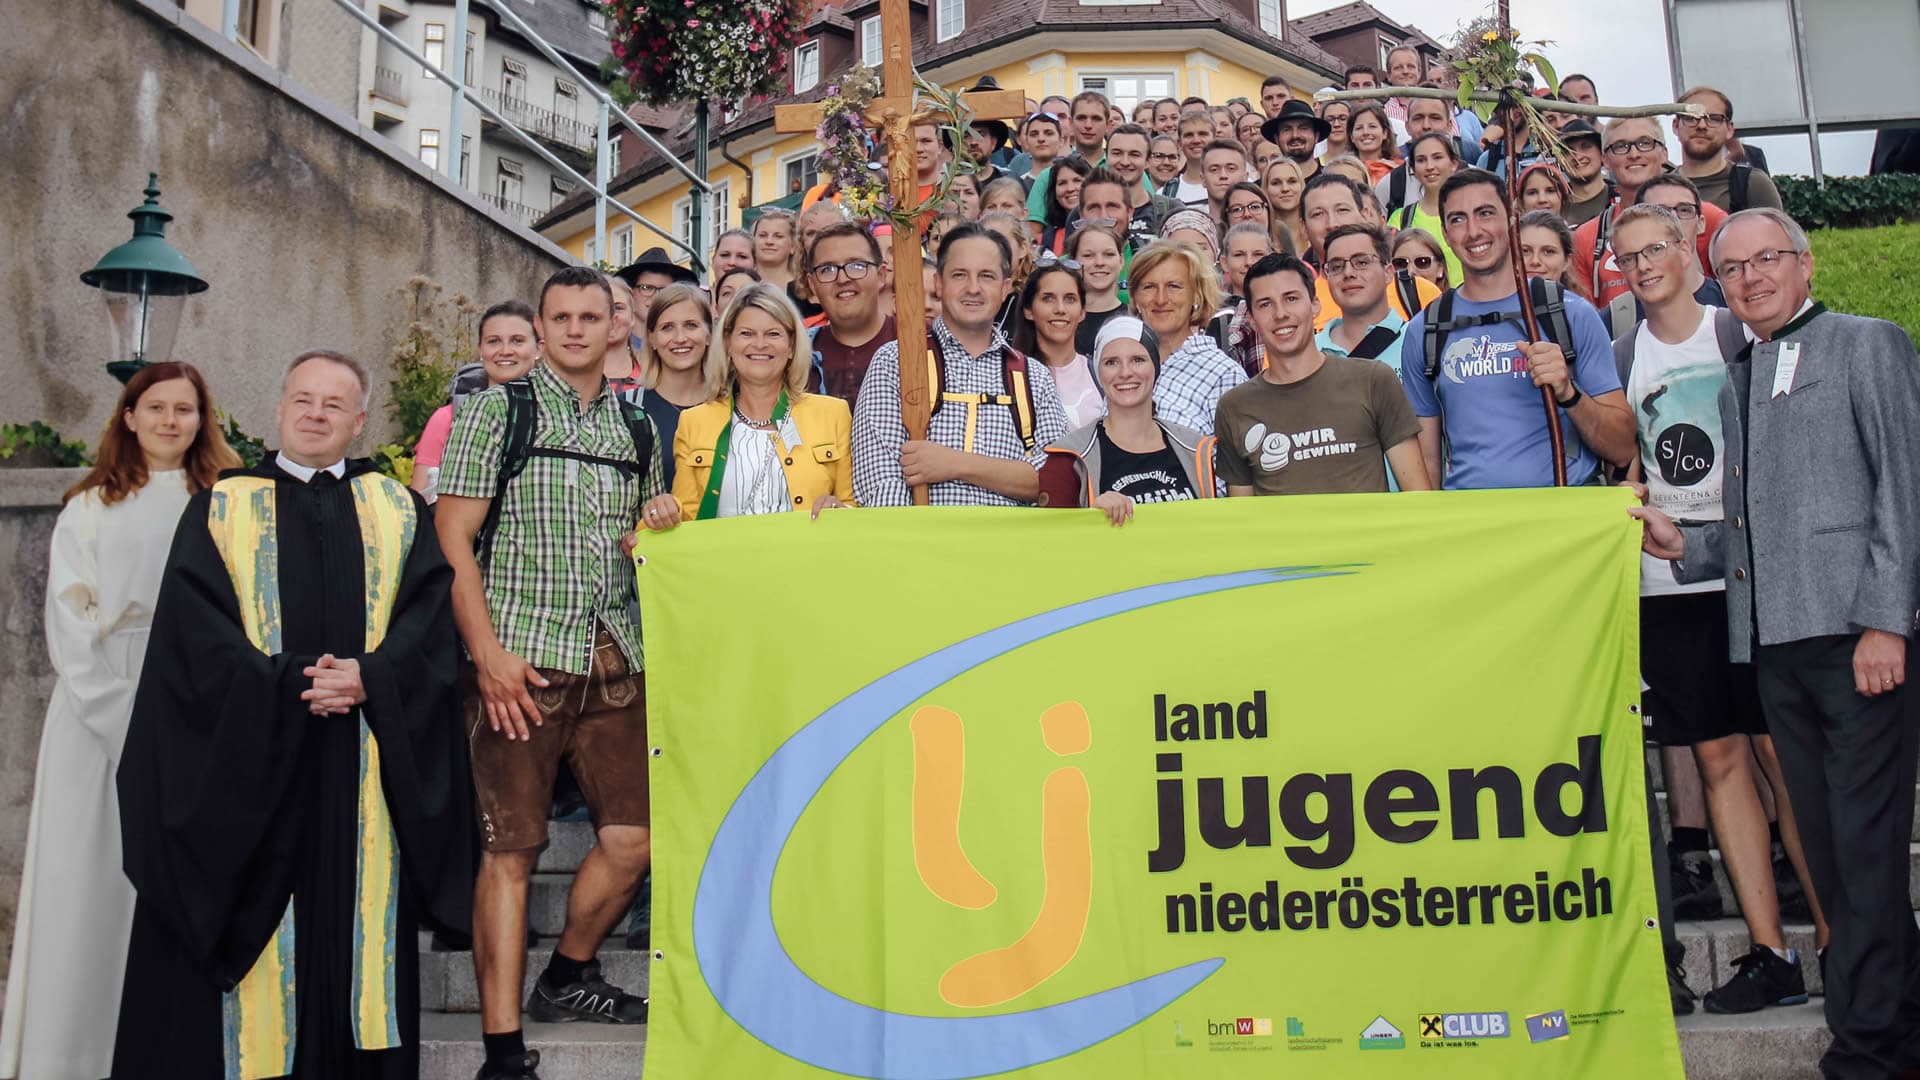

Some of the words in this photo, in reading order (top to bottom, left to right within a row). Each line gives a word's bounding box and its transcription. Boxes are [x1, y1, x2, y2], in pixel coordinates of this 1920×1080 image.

[1460, 357, 1512, 377] WORLD
[1291, 427, 1337, 447] WIR
[1293, 442, 1357, 461] GEWINNT
[1153, 690, 1267, 742] land
[1148, 734, 1608, 873] jugend
[1165, 867, 1613, 933] niederösterreich
[1443, 1013, 1505, 1037] CLUB
[1542, 1016, 1562, 1028] NV
